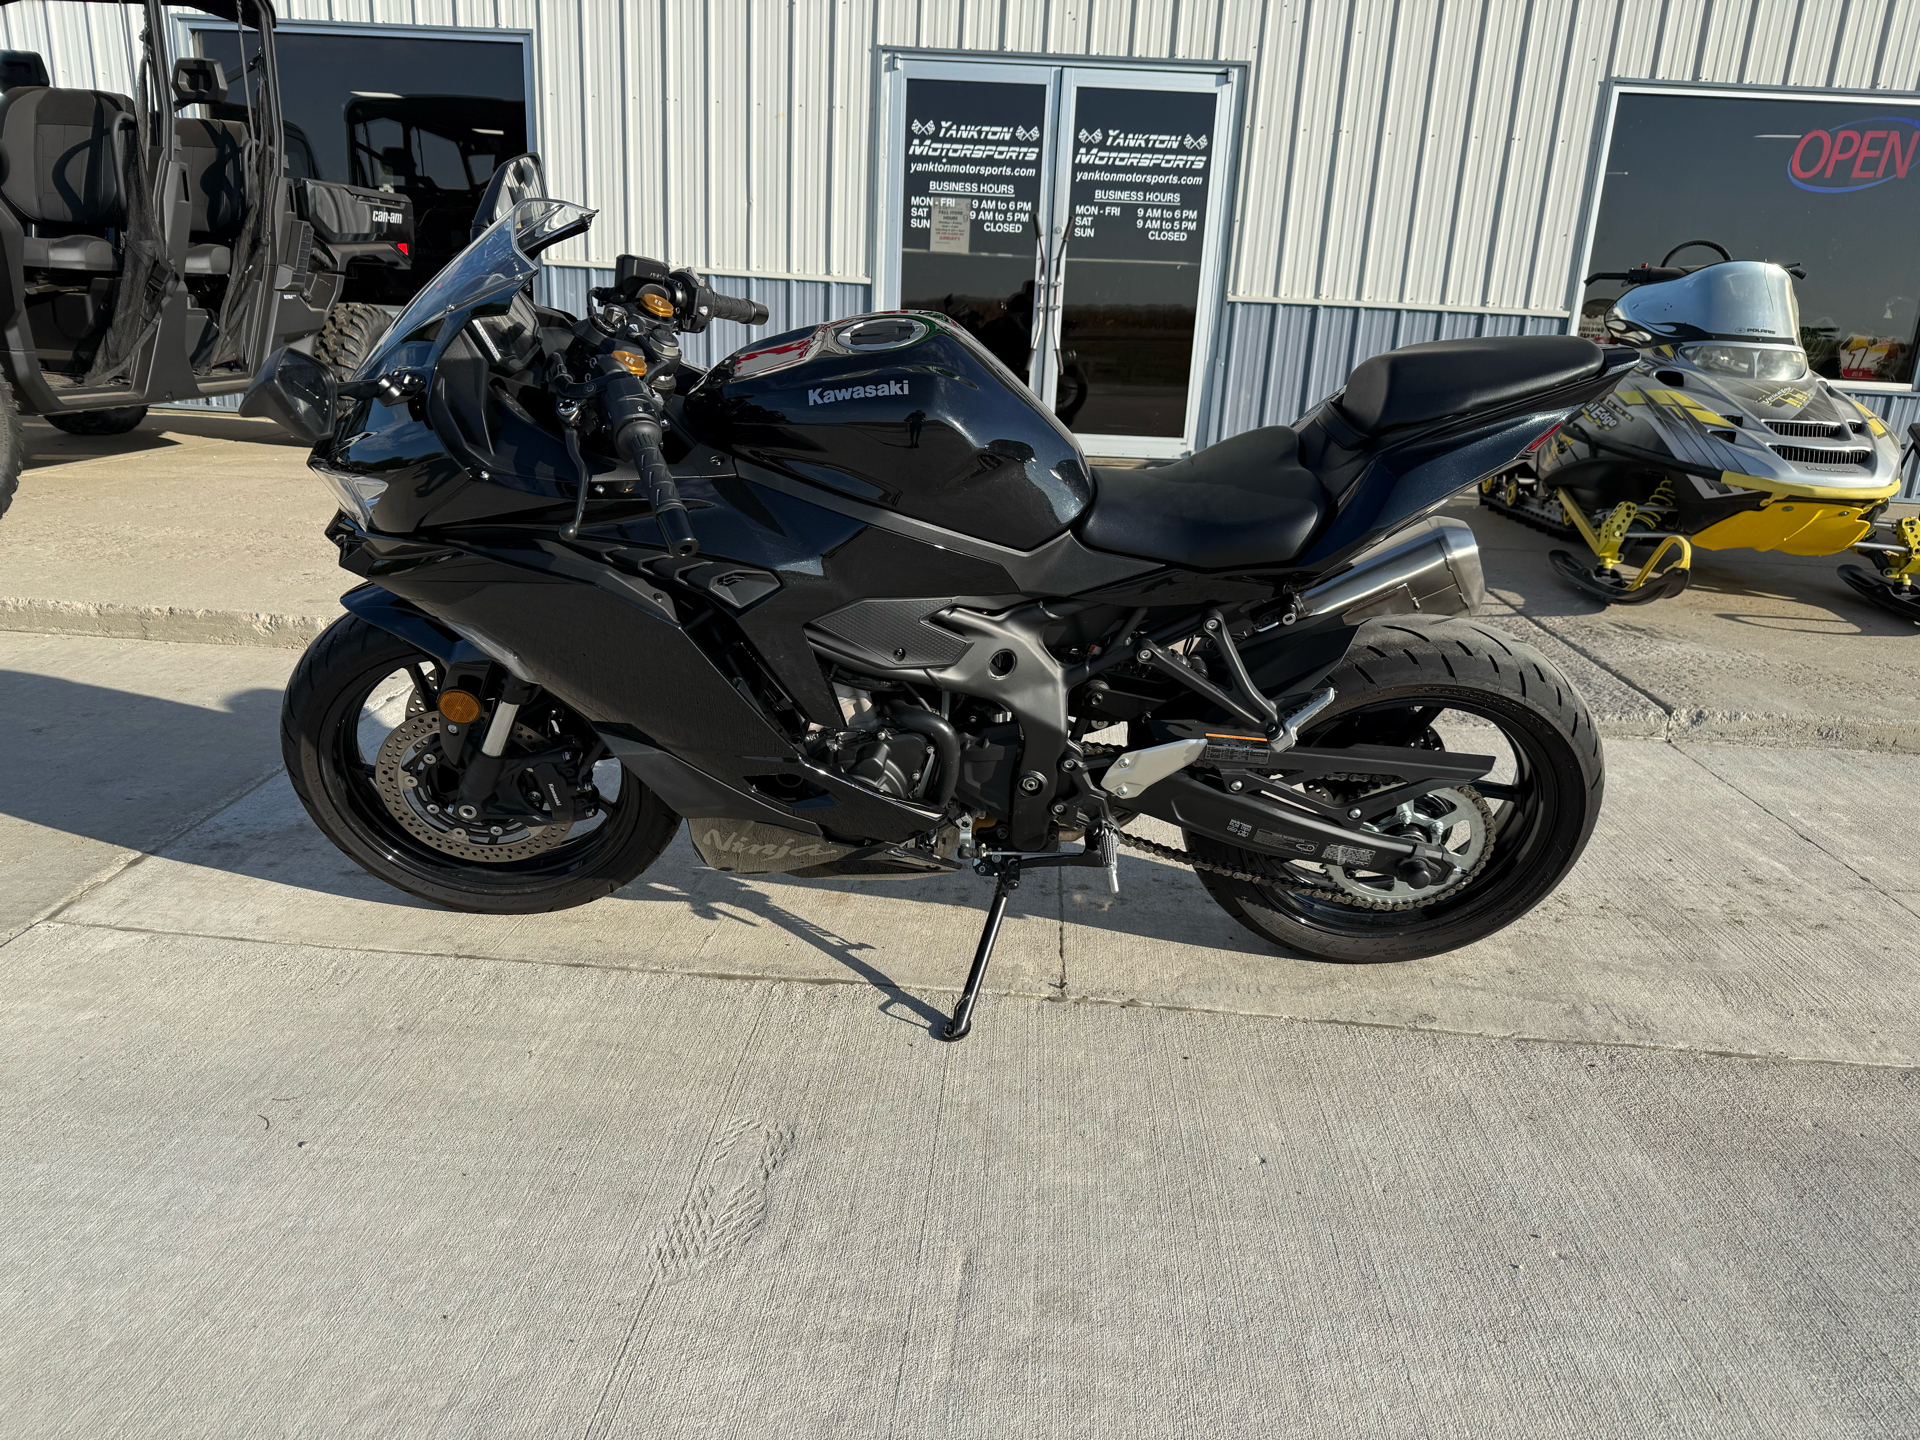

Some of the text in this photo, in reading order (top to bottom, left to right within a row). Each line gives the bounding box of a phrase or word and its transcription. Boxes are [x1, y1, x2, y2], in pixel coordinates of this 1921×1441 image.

[939, 121, 1014, 140] YANKTON
[1106, 129, 1182, 149] YANKTON
[908, 138, 1039, 160] MOTORSPORTS
[1791, 129, 1920, 178] OPEN
[1074, 147, 1207, 169] MOTORSPORTS
[910, 161, 1036, 177] yanktonmotorsports.com
[1076, 170, 1203, 185] yanktonmotorsports.com
[929, 181, 1014, 194] BUSINESS HOURS
[910, 196, 934, 207] MON
[940, 198, 955, 208] FRI
[972, 199, 979, 209] 9
[980, 200, 996, 210] AM
[997, 200, 1006, 210] to
[1009, 201, 1016, 211] 6
[1017, 201, 1031, 211] PM
[1094, 190, 1180, 203] BUSINESS HOURS
[372, 210, 403, 224] can-am
[910, 207, 1029, 222] SAT 9 AM to 5 PM
[1075, 205, 1098, 215] MON
[1105, 206, 1120, 216] FRI
[1137, 208, 1144, 217] 9
[1145, 208, 1161, 218] AM
[1163, 209, 1172, 219] to
[1174, 209, 1181, 219] 6
[1182, 210, 1198, 220] PM
[910, 218, 1023, 233] SUN CLOSED
[1075, 216, 1197, 231] SAT 9 AM to 5 PM
[1074, 227, 1188, 241] SUN CLOSED
[808, 380, 909, 406] Kawasaki
[703, 828, 837, 861] Ninja
